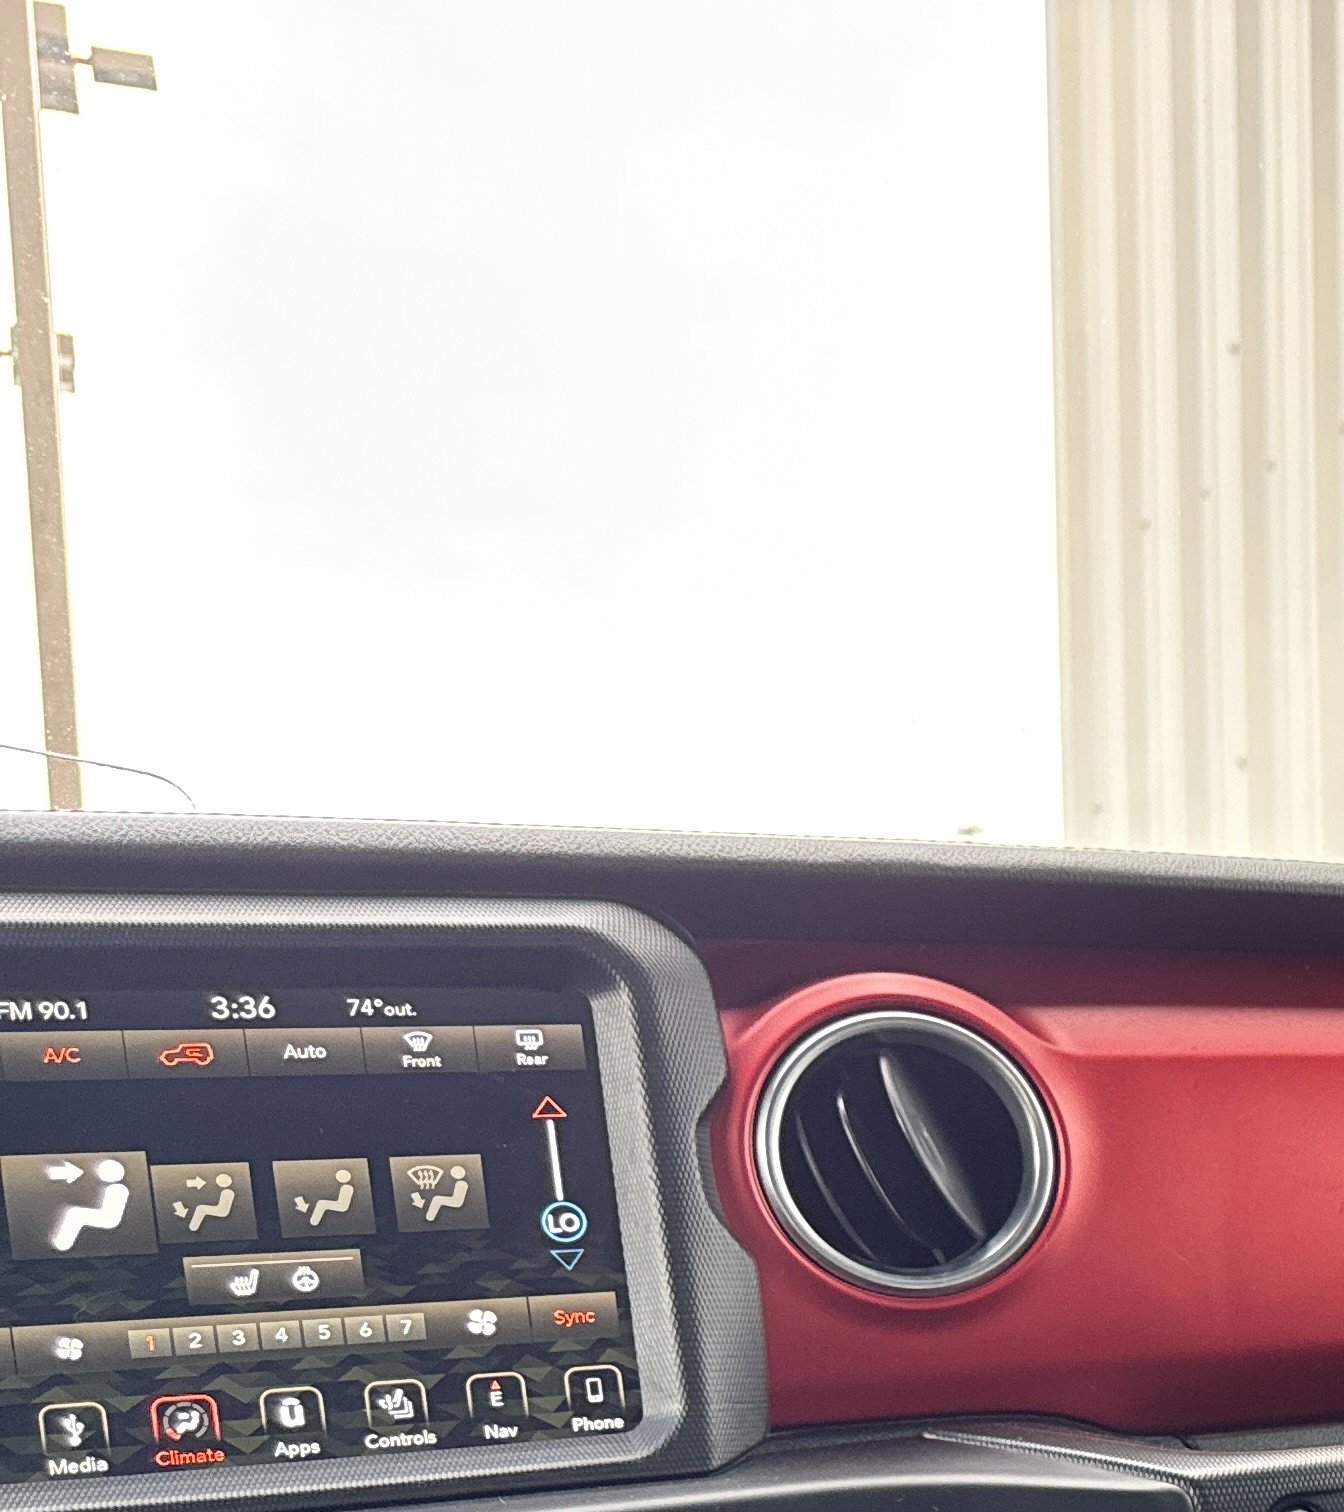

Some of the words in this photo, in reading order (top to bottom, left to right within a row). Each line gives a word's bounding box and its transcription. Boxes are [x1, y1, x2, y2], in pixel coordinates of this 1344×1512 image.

[38, 1001, 87, 1020] 90.1
[211, 996, 276, 1019] 3:36
[43, 1047, 81, 1064] A/C
[283, 1043, 326, 1060] Auto
[402, 1054, 442, 1068] Front
[516, 1053, 549, 1067] Rear
[547, 1213, 580, 1233] LO
[553, 1309, 596, 1327] Sync
[145, 1335, 157, 1352] 1
[187, 1332, 203, 1349] 2
[231, 1329, 246, 1346] 3
[275, 1327, 289, 1343] 4
[317, 1324, 331, 1340] 5
[359, 1321, 373, 1337] 6
[399, 1319, 412, 1335] 7
[483, 1424, 518, 1440] Nav
[572, 1416, 625, 1432] Phone
[274, 1438, 321, 1460] Apps
[364, 1430, 438, 1449] Controls
[48, 1456, 109, 1476] Media
[155, 1448, 225, 1467] Climate
